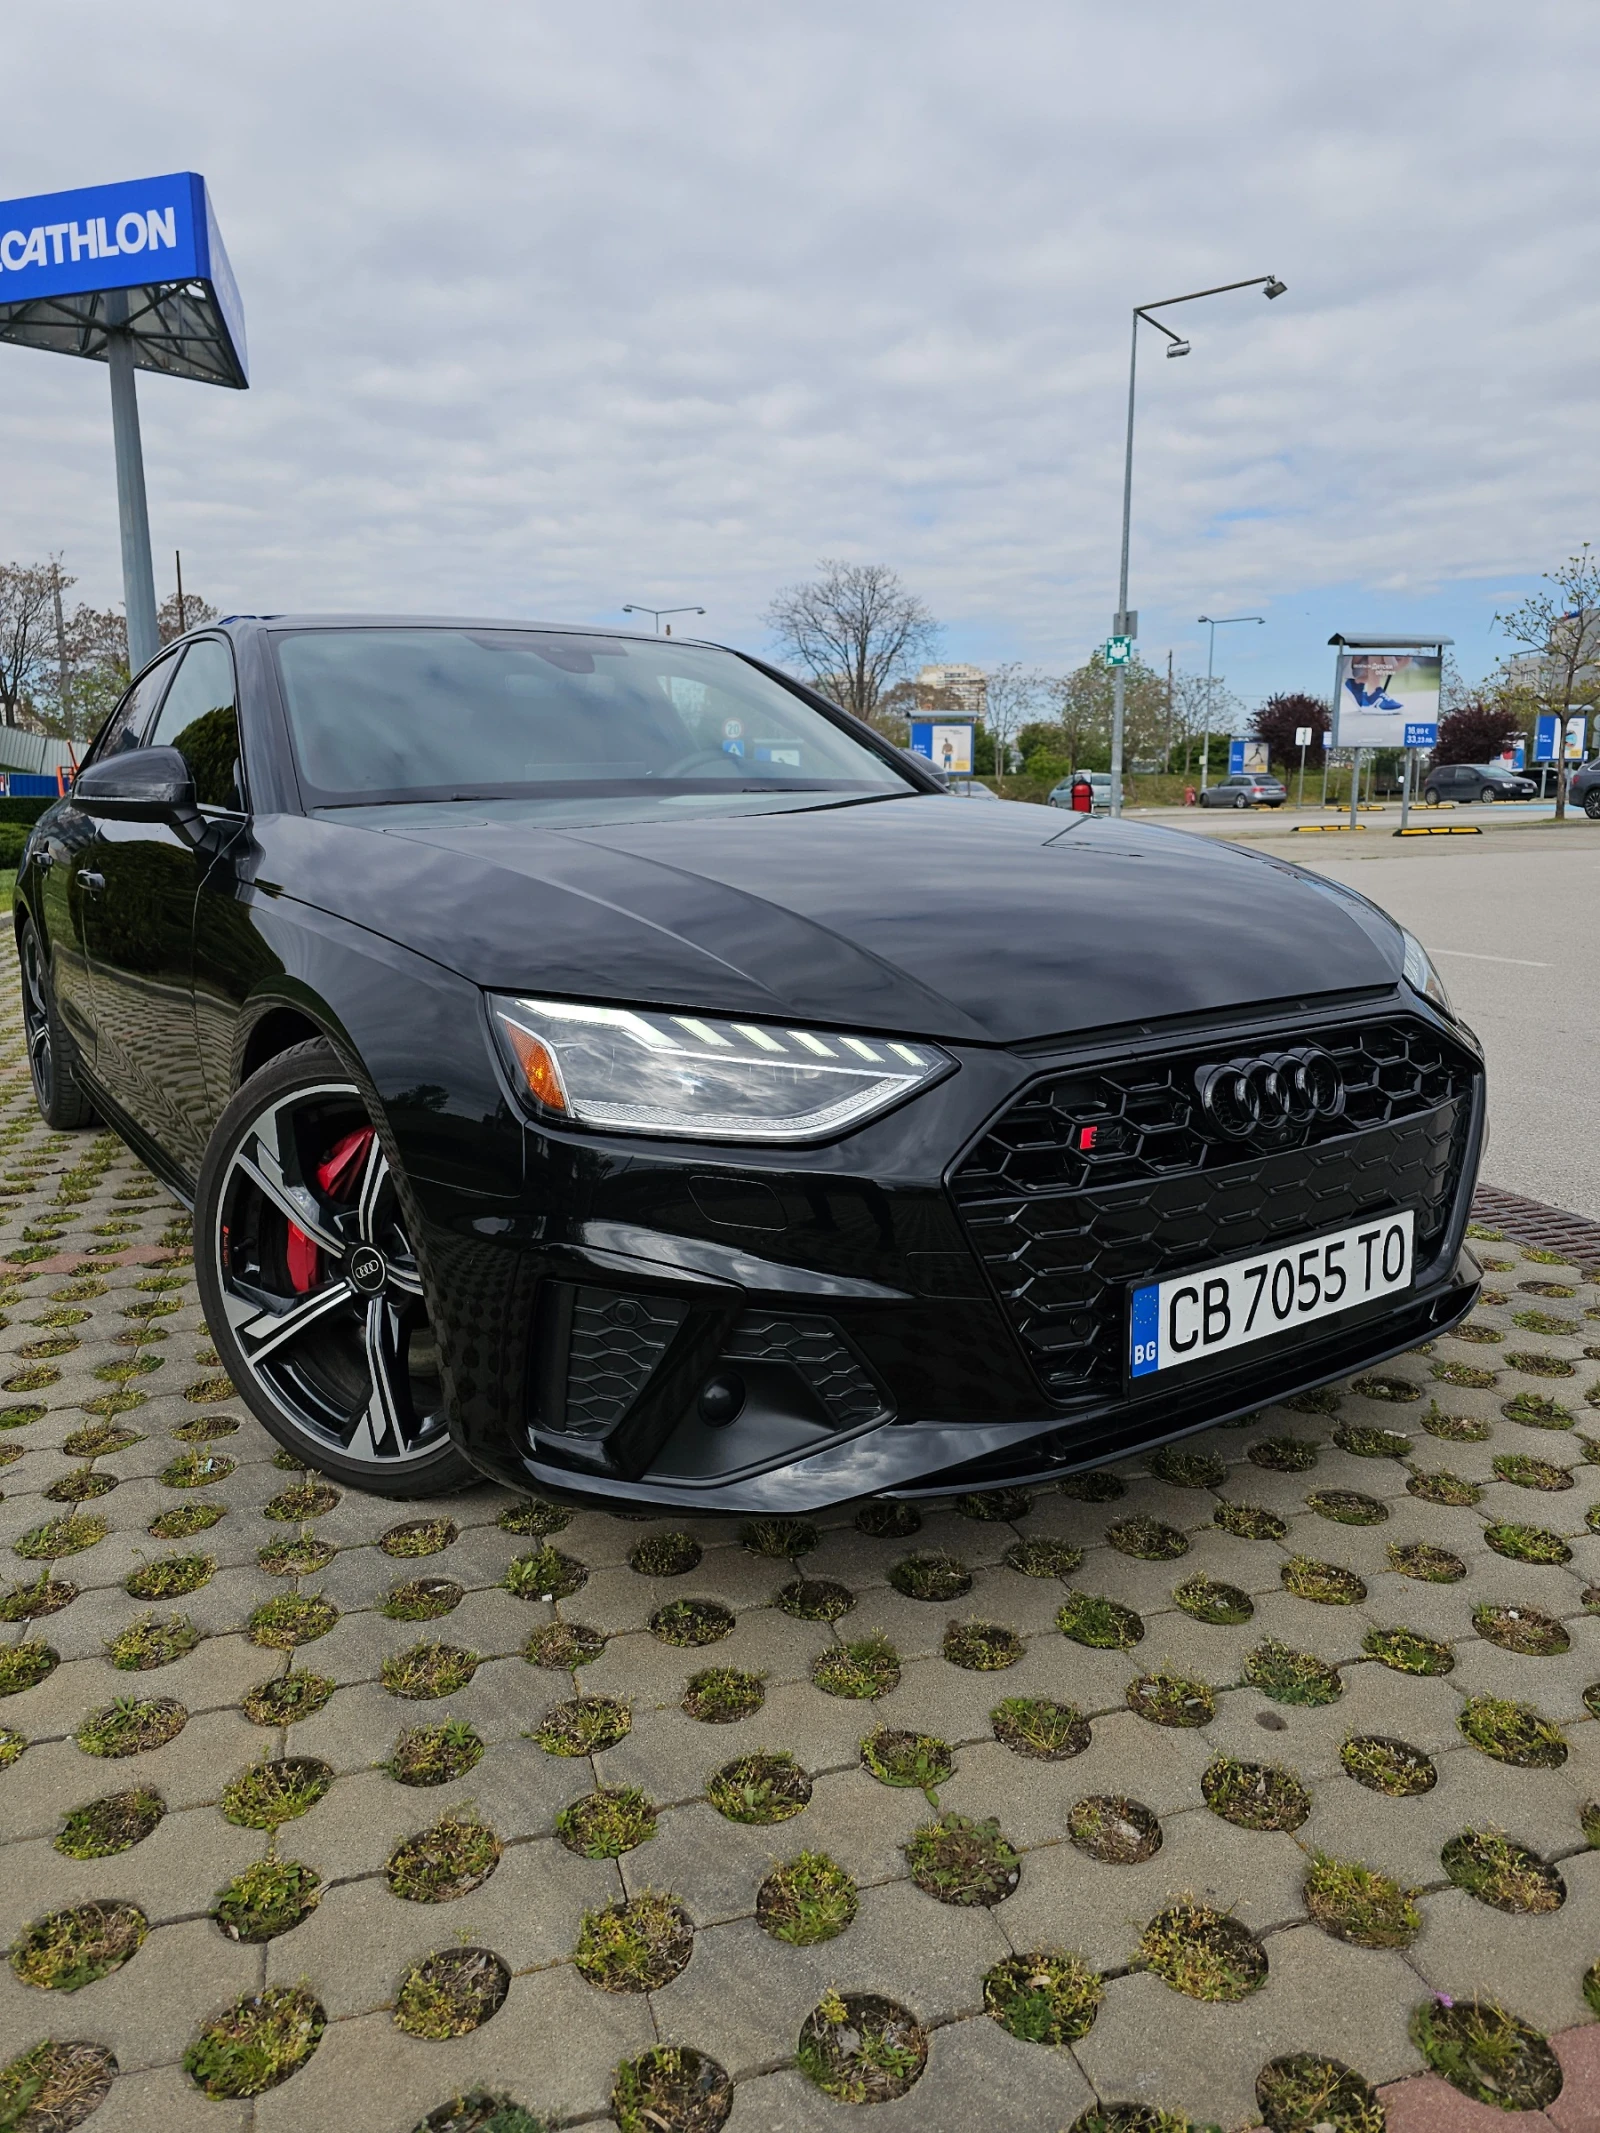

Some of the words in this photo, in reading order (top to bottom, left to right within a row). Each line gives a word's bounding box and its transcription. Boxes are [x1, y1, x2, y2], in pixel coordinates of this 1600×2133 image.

[0, 207, 176, 272] CATHLON
[1169, 1277, 1231, 1353] CB
[1243, 1240, 1347, 1334] 7055
[1357, 1224, 1405, 1292] TO
[1134, 1341, 1157, 1365] BG
